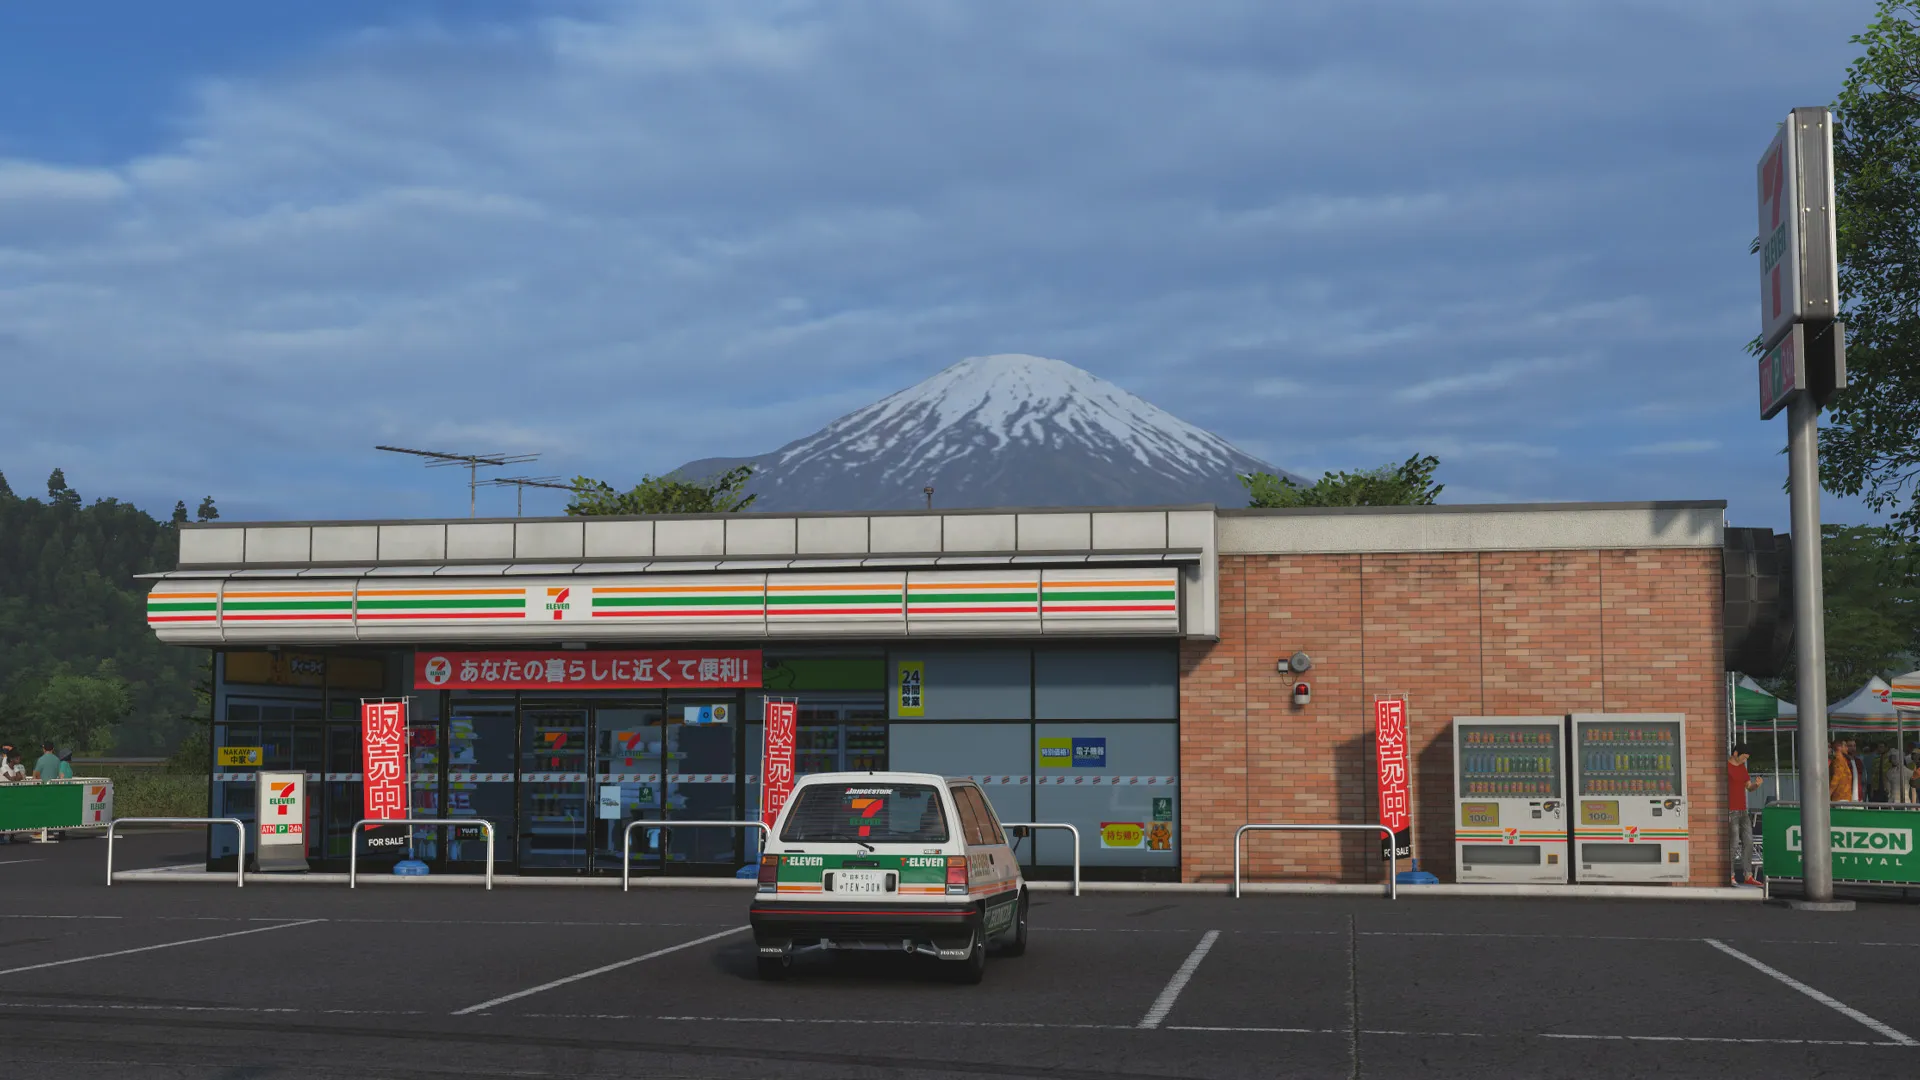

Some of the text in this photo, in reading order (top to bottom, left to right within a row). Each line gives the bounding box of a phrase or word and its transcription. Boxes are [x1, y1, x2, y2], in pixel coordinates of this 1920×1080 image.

[1763, 141, 1783, 320] 7
[547, 588, 570, 620] 7
[431, 661, 446, 682] 7
[902, 669, 921, 684] 24
[366, 703, 403, 820] 販売中
[544, 732, 567, 766] 7
[617, 732, 641, 766] 7
[1378, 701, 1407, 828] 販売中
[91, 786, 107, 821] 7
[270, 782, 295, 815] 7
[845, 787, 893, 795] BRIDGESTONE
[851, 798, 884, 836] 7
[368, 837, 404, 847] FOR SALE
[1395, 846, 1409, 856] SALE
[1792, 830, 1907, 851] HRIZON
[1797, 855, 1902, 866] FTIVAL
